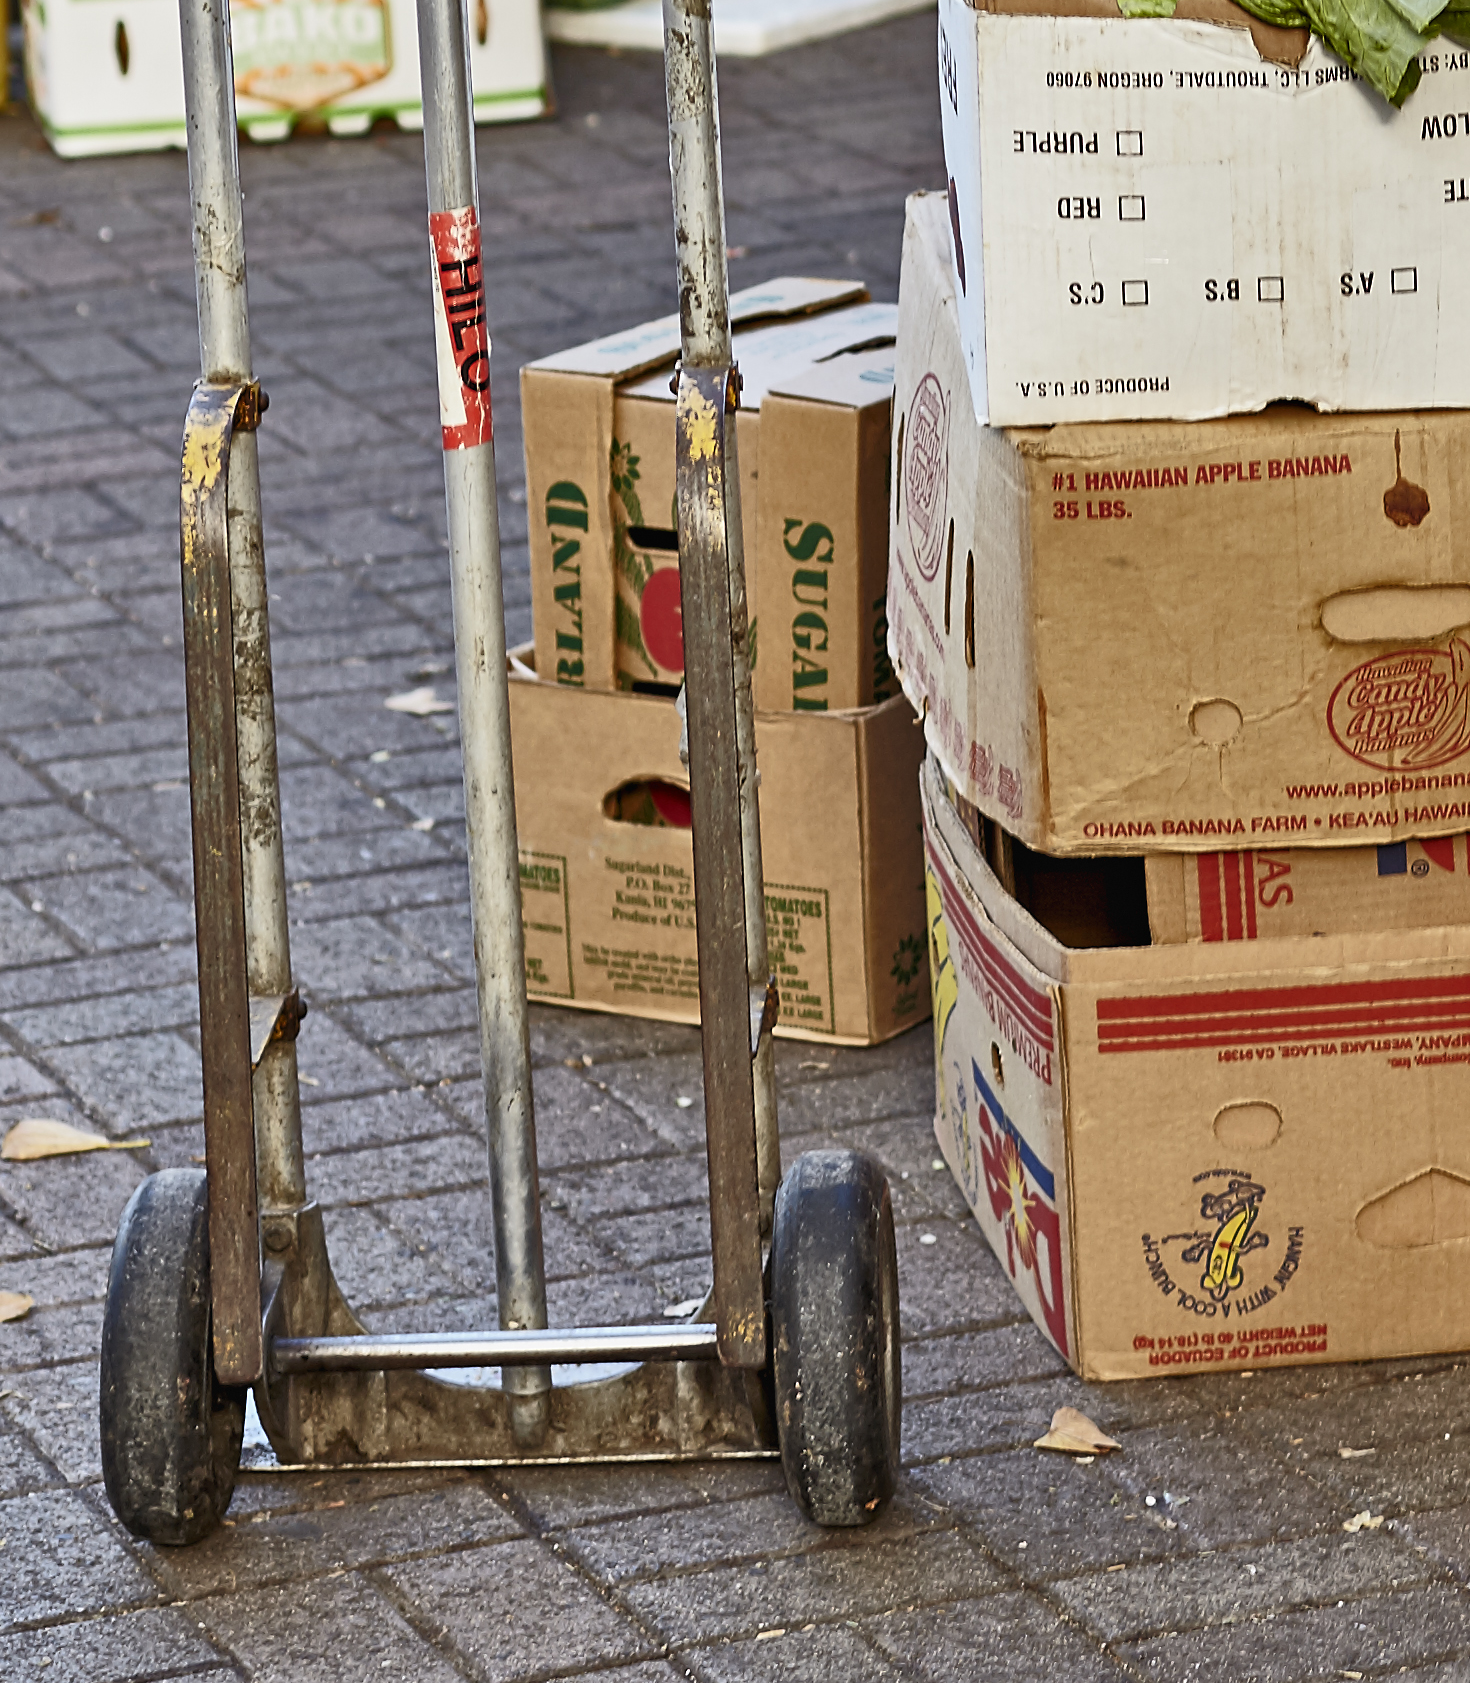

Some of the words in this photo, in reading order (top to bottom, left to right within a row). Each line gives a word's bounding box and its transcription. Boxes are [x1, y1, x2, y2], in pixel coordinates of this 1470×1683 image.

[1444, 51, 1469, 71] BY:
[1046, 71, 1092, 88] 97060
[1098, 71, 1163, 89] OREGON
[1169, 70, 1269, 89] TROUTDALE,
[1274, 70, 1310, 89] LLC,
[1012, 130, 1099, 155] PURPLE
[1056, 196, 1100, 219] RED
[1068, 281, 1105, 306] C'S
[1203, 278, 1241, 302] B'S
[1339, 272, 1375, 296] A'S
[441, 255, 490, 392] HILO
[1015, 380, 1066, 398] U.S.A.
[1070, 379, 1090, 397] OF
[1095, 376, 1170, 395] PRODUCE
[1052, 471, 1079, 493] #1
[1084, 467, 1190, 491] HAWAIIAN
[1195, 461, 1263, 485] APPLE
[1268, 452, 1352, 481] BANANA
[1052, 499, 1080, 519] 35
[1085, 499, 1132, 520] LBS.
[1347, 669, 1447, 709] Candy
[1346, 697, 1438, 743] Apple
[1083, 820, 1155, 839] OHANA
[1161, 817, 1245, 837] BANANA
[1250, 814, 1307, 834] FARM
[1329, 808, 1399, 830] KEA'AU
[997, 1000, 1053, 1086] PREMIUM
[1177, 1289, 1217, 1317] COOL
[1222, 1302, 1231, 1319] A
[1236, 1285, 1277, 1316] WITH
[1218, 1333, 1234, 1344] 40
[1300, 1324, 1327, 1337] NET
[1149, 1347, 1224, 1366] ECUADOR
[1228, 1346, 1249, 1361] OF
[1253, 1339, 1327, 1359] PRODUCT
